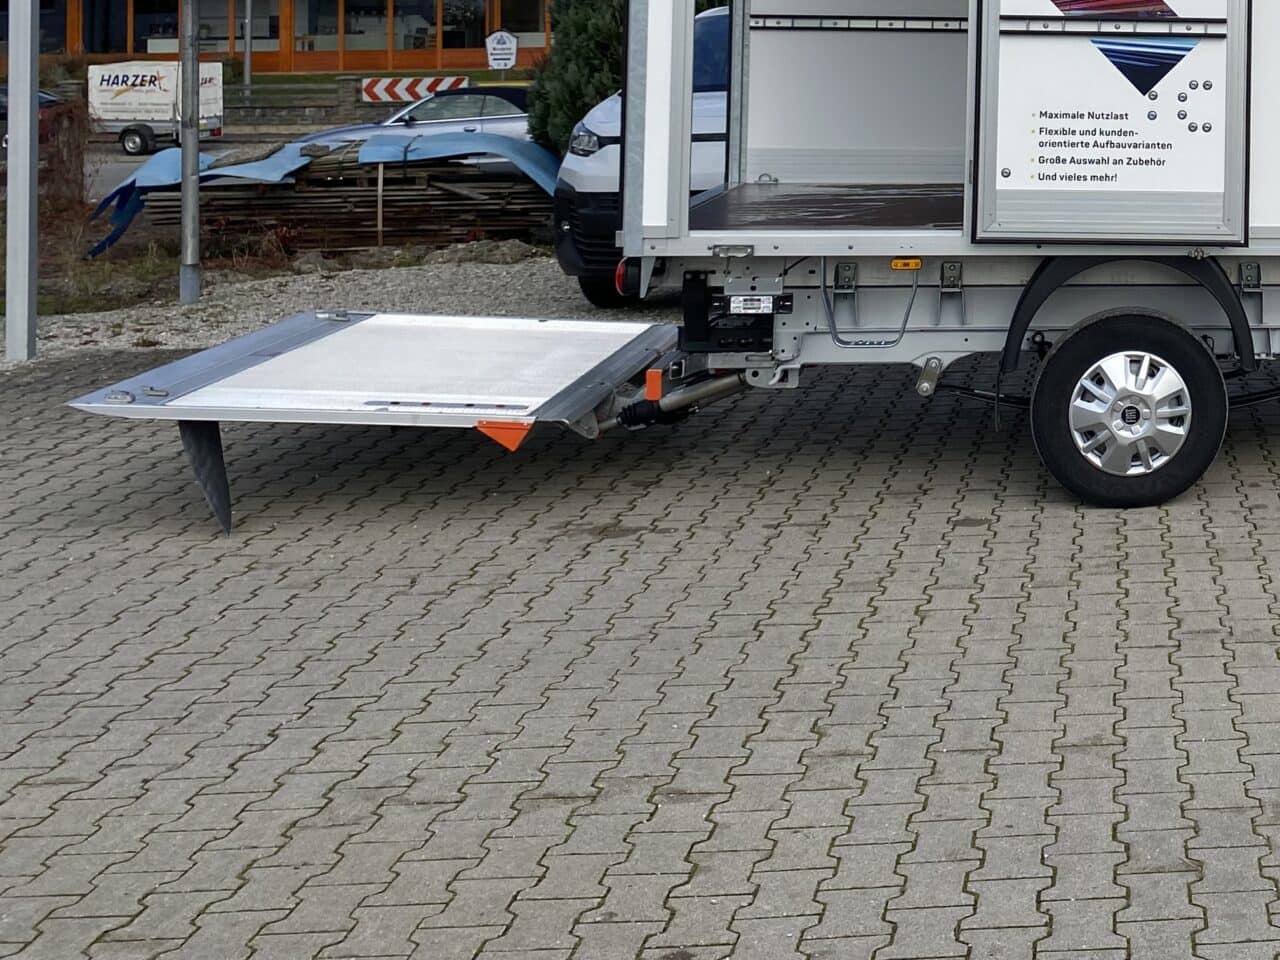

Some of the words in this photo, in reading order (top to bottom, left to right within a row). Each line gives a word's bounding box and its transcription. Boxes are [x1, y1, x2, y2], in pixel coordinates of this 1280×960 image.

[99, 74, 158, 87] HARZER
[1039, 111, 1085, 120] Maximale
[1087, 111, 1129, 120] Nutzlast
[1039, 127, 1077, 136] Flexible
[1079, 128, 1097, 136] und
[1099, 128, 1139, 137] kunden-
[1038, 140, 1090, 149] orientierte
[1092, 140, 1172, 150] Aufbauvarianten
[1038, 156, 1067, 165] Große
[1069, 156, 1110, 166] Auswahl
[1112, 158, 1124, 166] an
[1126, 157, 1166, 166] Zubehör
[1038, 172, 1057, 181] Und
[1059, 172, 1088, 182] vieles
[1090, 173, 1118, 182] mehr!
